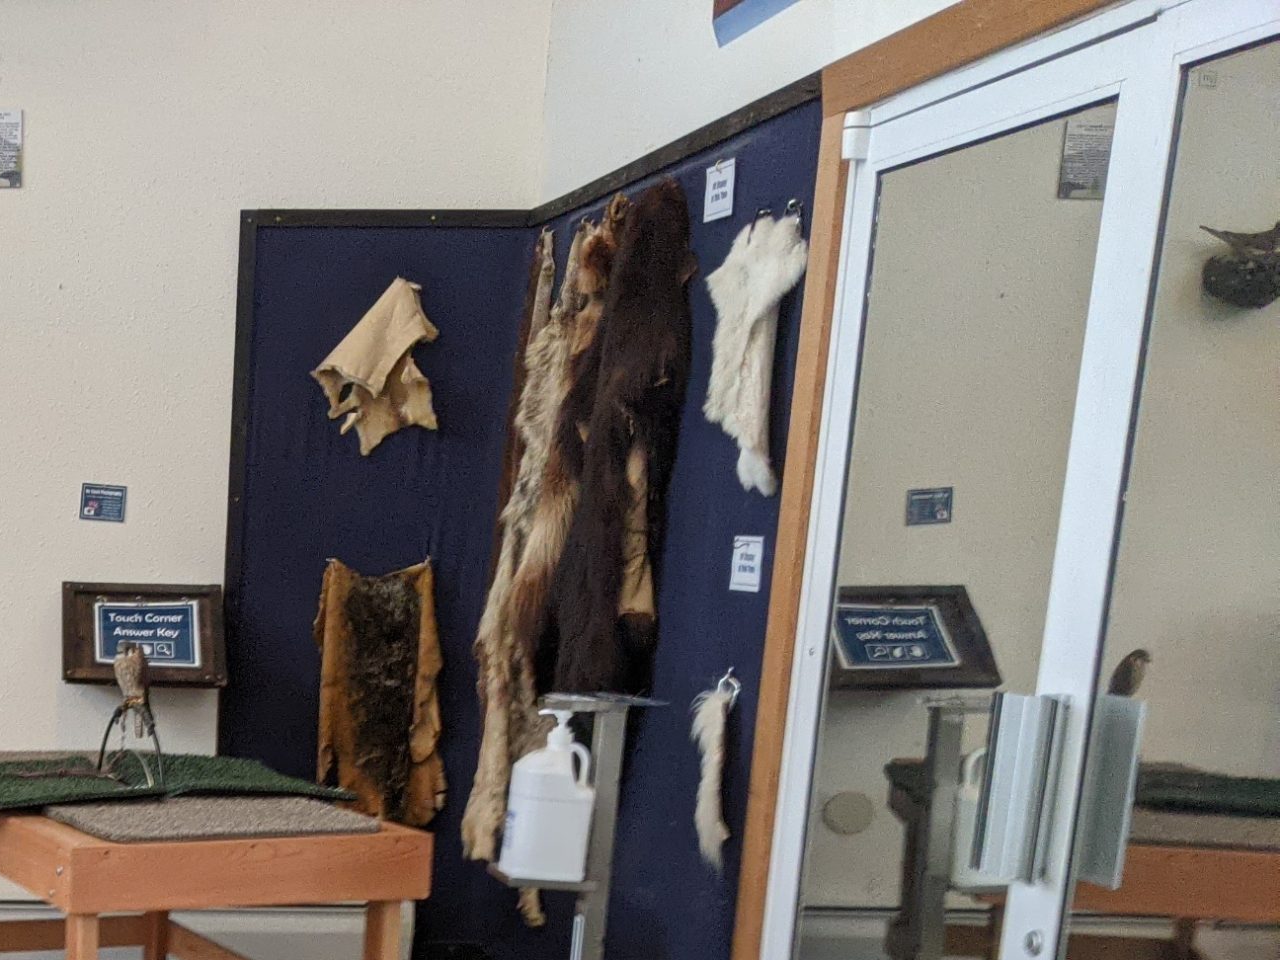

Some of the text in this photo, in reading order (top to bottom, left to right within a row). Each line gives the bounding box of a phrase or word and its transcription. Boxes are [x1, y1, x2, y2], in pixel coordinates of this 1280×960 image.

[108, 613, 183, 623] Touch Corner
[113, 627, 180, 639] Answer Key
